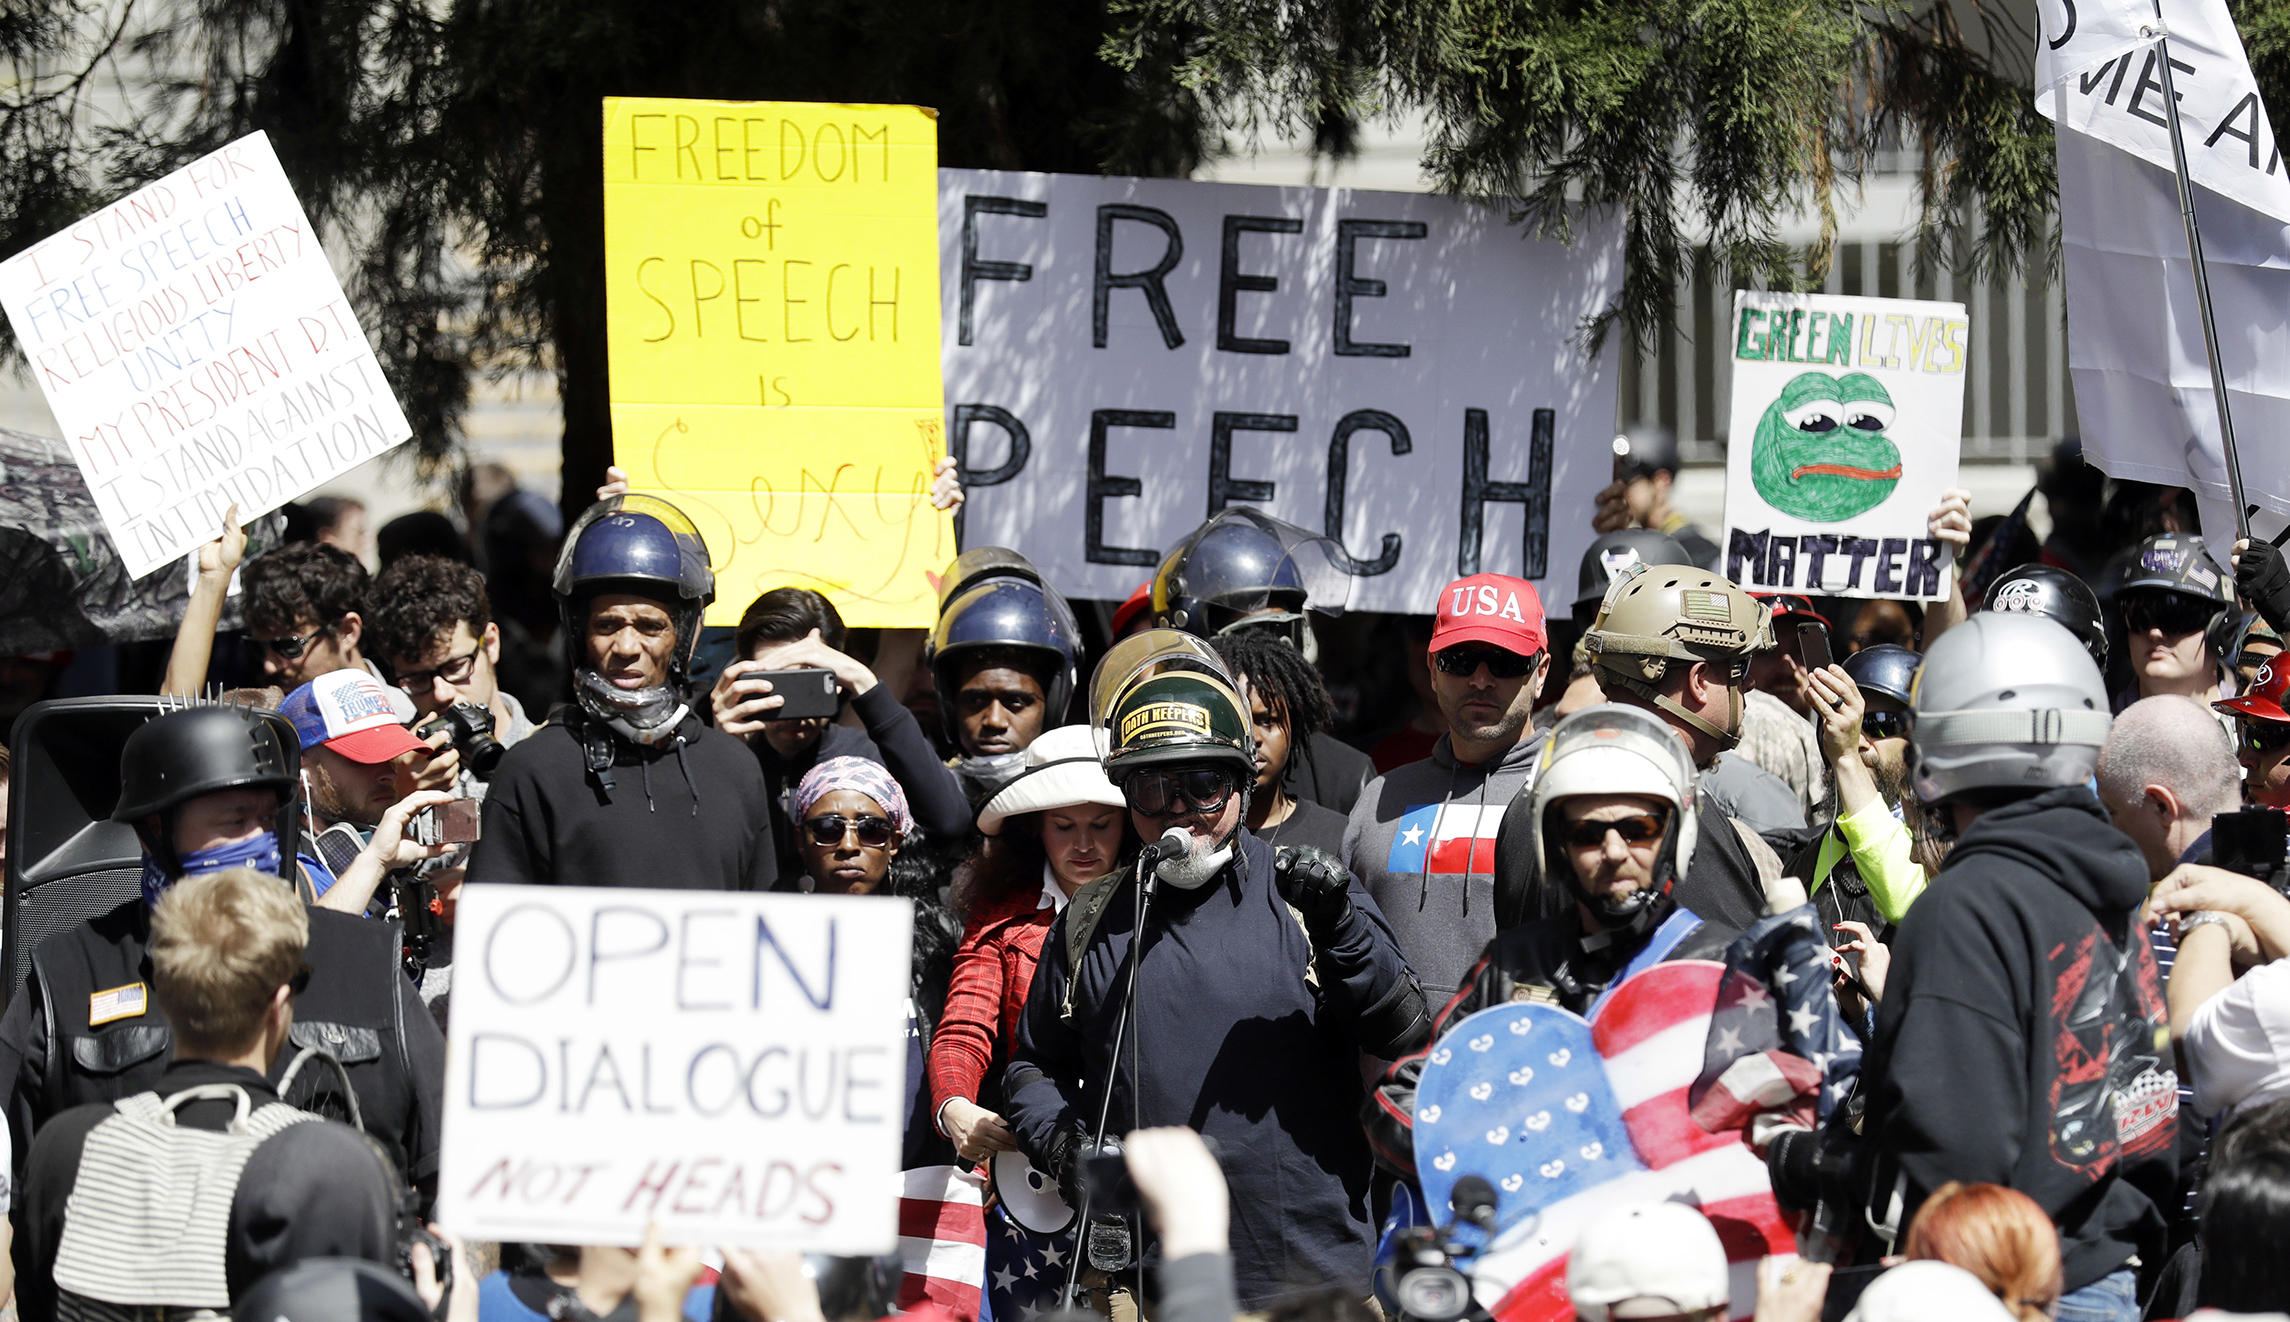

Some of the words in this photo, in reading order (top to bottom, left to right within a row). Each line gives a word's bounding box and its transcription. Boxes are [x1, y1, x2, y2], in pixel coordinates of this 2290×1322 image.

[631, 113, 890, 183] FREEDOM
[15, 243, 60, 292] I
[71, 185, 177, 265] STAND
[188, 146, 256, 199] FOR
[741, 198, 783, 252] of
[26, 267, 121, 342] FREE
[120, 196, 254, 292] SPEECH
[37, 281, 189, 392] RELIGIOUS
[193, 217, 302, 306] LIBERTY
[635, 257, 901, 342] SPEECH
[957, 195, 1429, 359] FREE
[122, 299, 236, 392] UNITY
[1735, 306, 1855, 367] GREEN
[1859, 312, 1968, 376] LIVES
[79, 410, 133, 475] MY
[131, 329, 293, 448] PRESIDENT
[759, 374, 791, 409] IS
[99, 475, 142, 526] I
[140, 424, 243, 496] STAND
[248, 353, 375, 453] AGAINST
[953, 403, 1556, 580] PEECH
[1451, 584, 1526, 624] USA
[1726, 526, 1944, 598] MATTER
[339, 695, 381, 718] TRUMP
[1124, 709, 1150, 736] OATH
[1152, 706, 1205, 727] KEEPERS
[484, 901, 838, 1012] OPEN
[468, 1032, 888, 1124] DIALOGUE
[467, 1156, 614, 1209] NOT
[621, 1156, 846, 1227] HEADS
